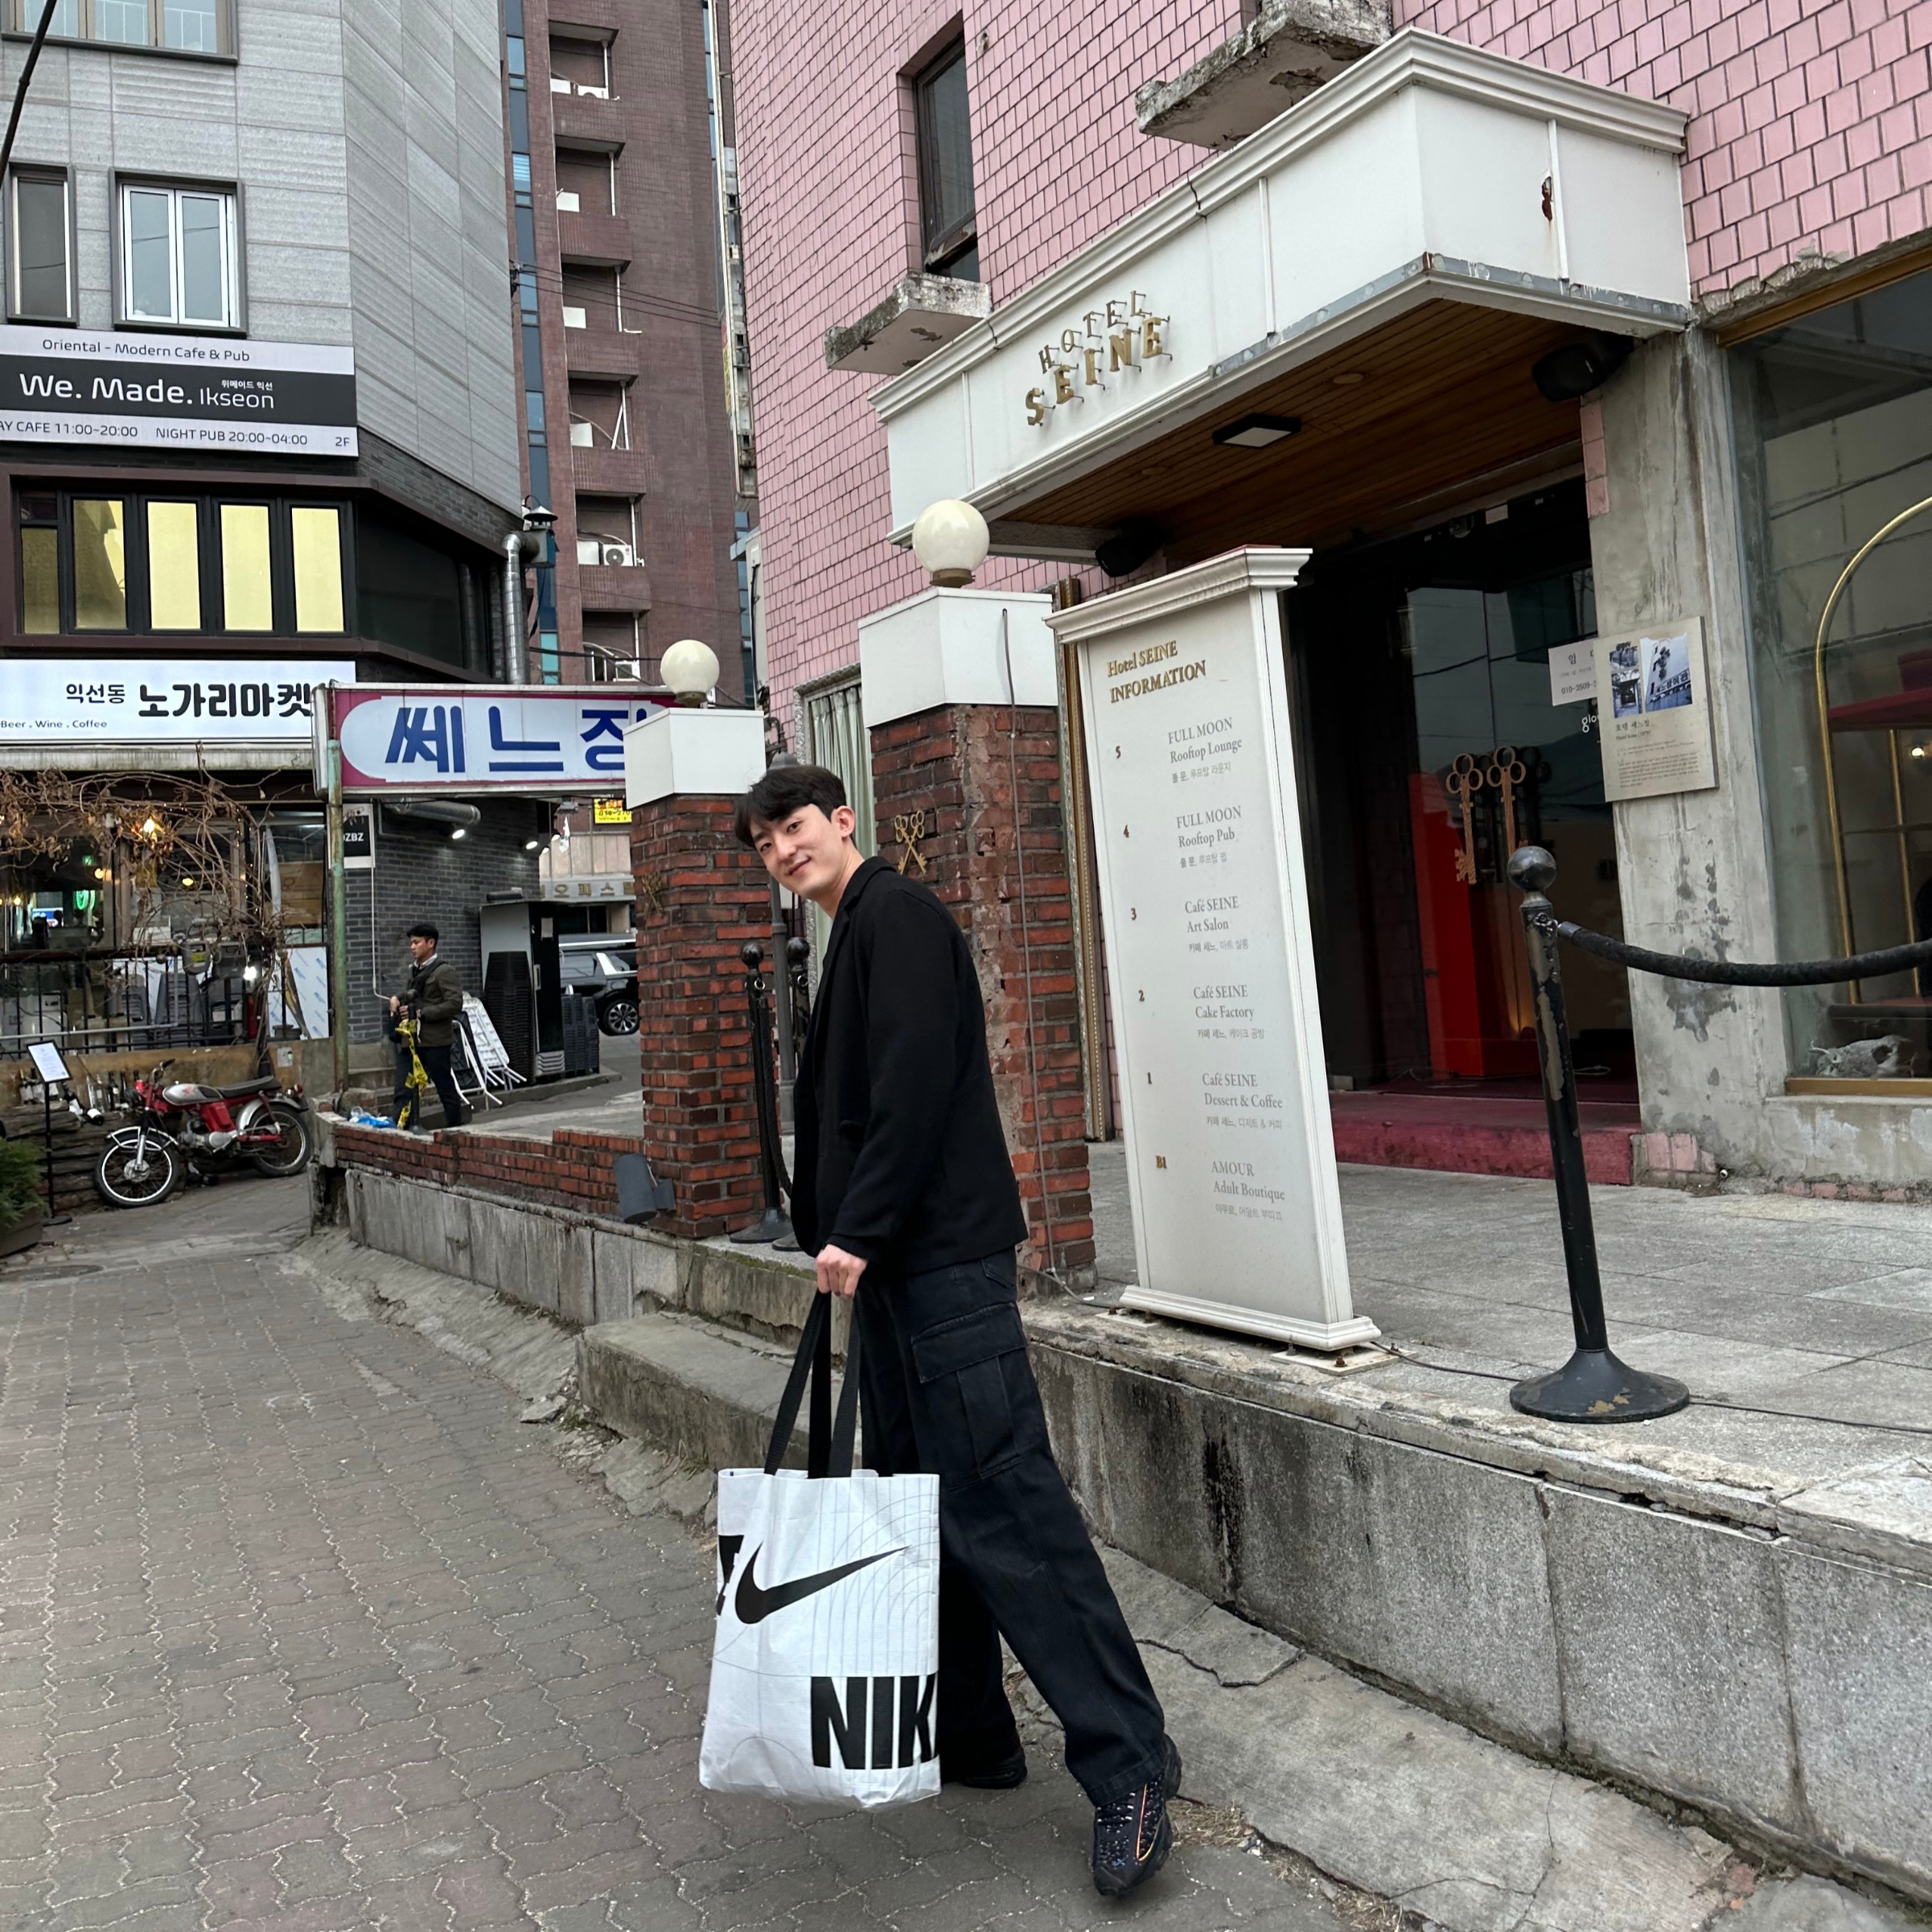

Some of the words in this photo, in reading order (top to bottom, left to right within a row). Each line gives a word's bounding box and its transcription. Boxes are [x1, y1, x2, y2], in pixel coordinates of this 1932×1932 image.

[1038, 290, 1144, 373] HOTEL
[43, 339, 101, 352] Oriental
[115, 343, 171, 357] Modern
[175, 347, 206, 360] Cafe
[209, 349, 220, 360] &
[224, 350, 249, 361] Pub
[1026, 317, 1164, 425] SEINE
[19, 373, 82, 399] We.
[92, 376, 193, 405] Made.
[199, 387, 274, 409] Ikseon
[221, 380, 254, 389] 위메이드
[257, 381, 273, 391] 익선
[16, 421, 51, 433] CAFE
[55, 423, 138, 438] 11:00~20:00
[156, 428, 196, 440] NIGHT
[199, 430, 225, 442] PUB
[228, 431, 307, 446] 20:00~04:00
[335, 437, 351, 447] 2F
[1108, 652, 1137, 677] Hotel
[1139, 640, 1178, 667] SEINE
[1568, 653, 1576, 664] 임
[1110, 660, 1206, 703] INFORMATION
[66, 683, 125, 705] 익선동
[138, 683, 314, 717] 노가리마켓
[35, 720, 63, 728] Wine
[72, 720, 107, 728] Coffee
[1168, 727, 1196, 744] FULL
[1196, 717, 1232, 738] MOON
[1582, 713, 1599, 733] glo
[1116, 746, 1121, 758] 5
[1170, 746, 1206, 763] Rooftop
[1208, 739, 1242, 754] Lounge
[1211, 761, 1231, 775] 라운지
[1176, 813, 1203, 828] FULL
[1205, 805, 1241, 824] MOON
[343, 832, 364, 842] ZBZ
[1124, 824, 1129, 838] 4
[1178, 831, 1215, 848] Rooftop
[1216, 826, 1235, 841] Pub
[1185, 898, 1205, 914] Café
[1206, 896, 1239, 911] SEINE
[1131, 908, 1137, 920] 3
[1187, 920, 1202, 933] Art
[1203, 917, 1229, 931] Salon
[1138, 989, 1145, 1001] 2
[1194, 985, 1214, 999] Café
[1215, 984, 1248, 998] SEINE
[1195, 1005, 1218, 1018] Cake
[1219, 1005, 1254, 1021] Factory
[1147, 1072, 1152, 1084] 1
[1202, 1072, 1223, 1086] Café
[1224, 1073, 1258, 1087] SEINE
[1204, 1092, 1238, 1106] Dessert
[1240, 1095, 1248, 1107] &
[1251, 1094, 1283, 1108] Coffee
[1156, 1155, 1167, 1169] B1
[1211, 1161, 1255, 1177] AMOUR
[1214, 1180, 1239, 1194] Adult
[1240, 1182, 1285, 1203] Boutique
